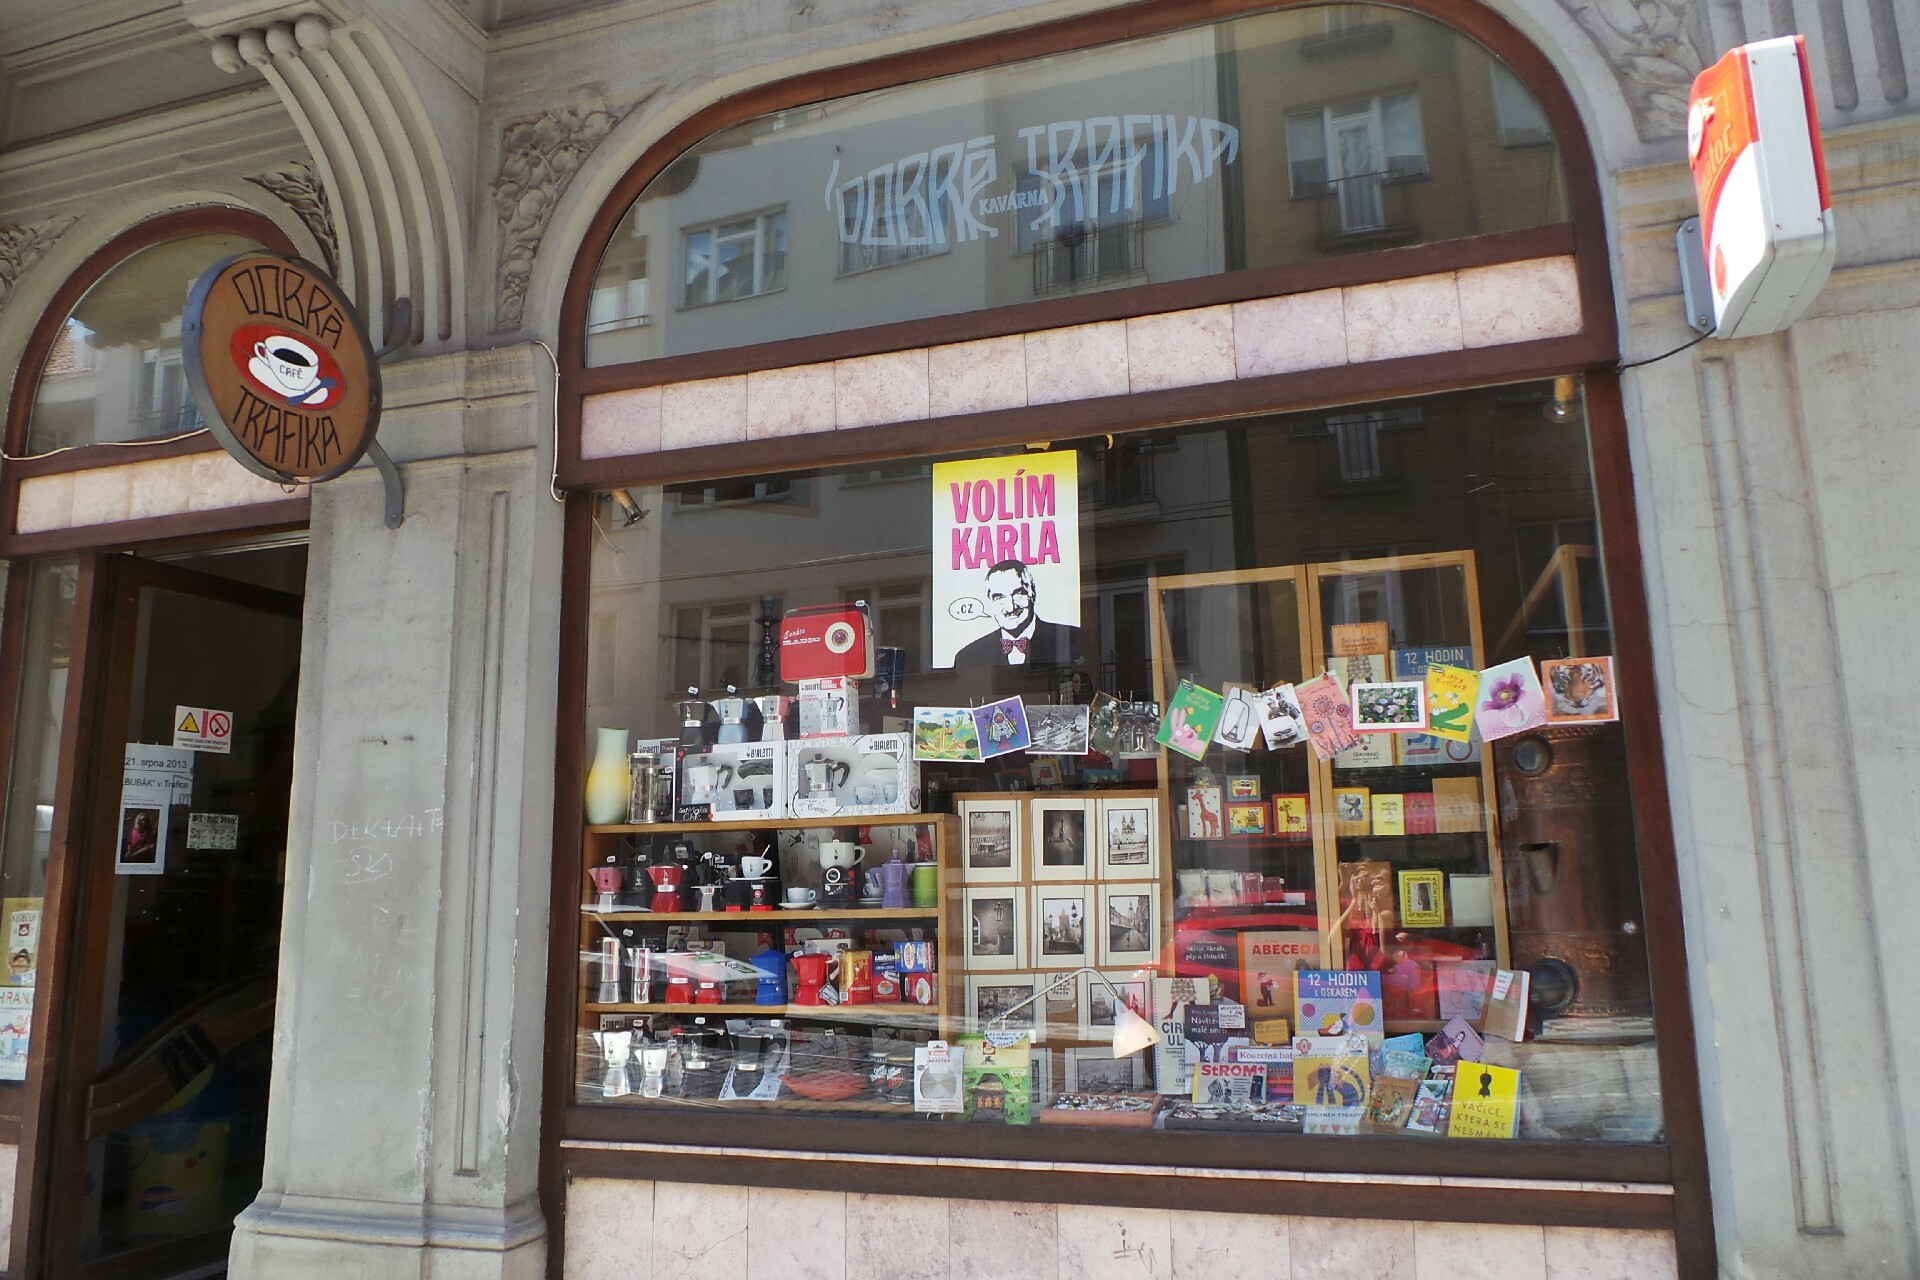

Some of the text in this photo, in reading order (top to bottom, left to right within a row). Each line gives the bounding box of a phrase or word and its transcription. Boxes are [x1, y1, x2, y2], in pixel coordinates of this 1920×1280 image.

[1018, 114, 1239, 231] TRAFIKA
[978, 189, 1050, 216] KAVÁRNA
[279, 363, 304, 381] CAFÉ
[233, 385, 342, 470] TRAFIKA
[950, 468, 1056, 523] VOLÍM
[951, 520, 1061, 570] KARLA
[956, 603, 974, 615] .CZ
[1404, 648, 1464, 664] 12 HODIN
[125, 757, 187, 768] 21. srpna 2013
[164, 780, 189, 789] Trafice
[1252, 944, 1320, 956] ABECEDA
[1307, 973, 1368, 986] 12 HODIN
[1320, 988, 1358, 997] OSKAREM
[1191, 1016, 1219, 1024] Návštěv
[1161, 1022, 1184, 1034] CIR
[1191, 1026, 1208, 1034] malé
[1168, 1035, 1184, 1046] UL
[1279, 1051, 1294, 1060] bat
[1494, 1121, 1507, 1131] SE
